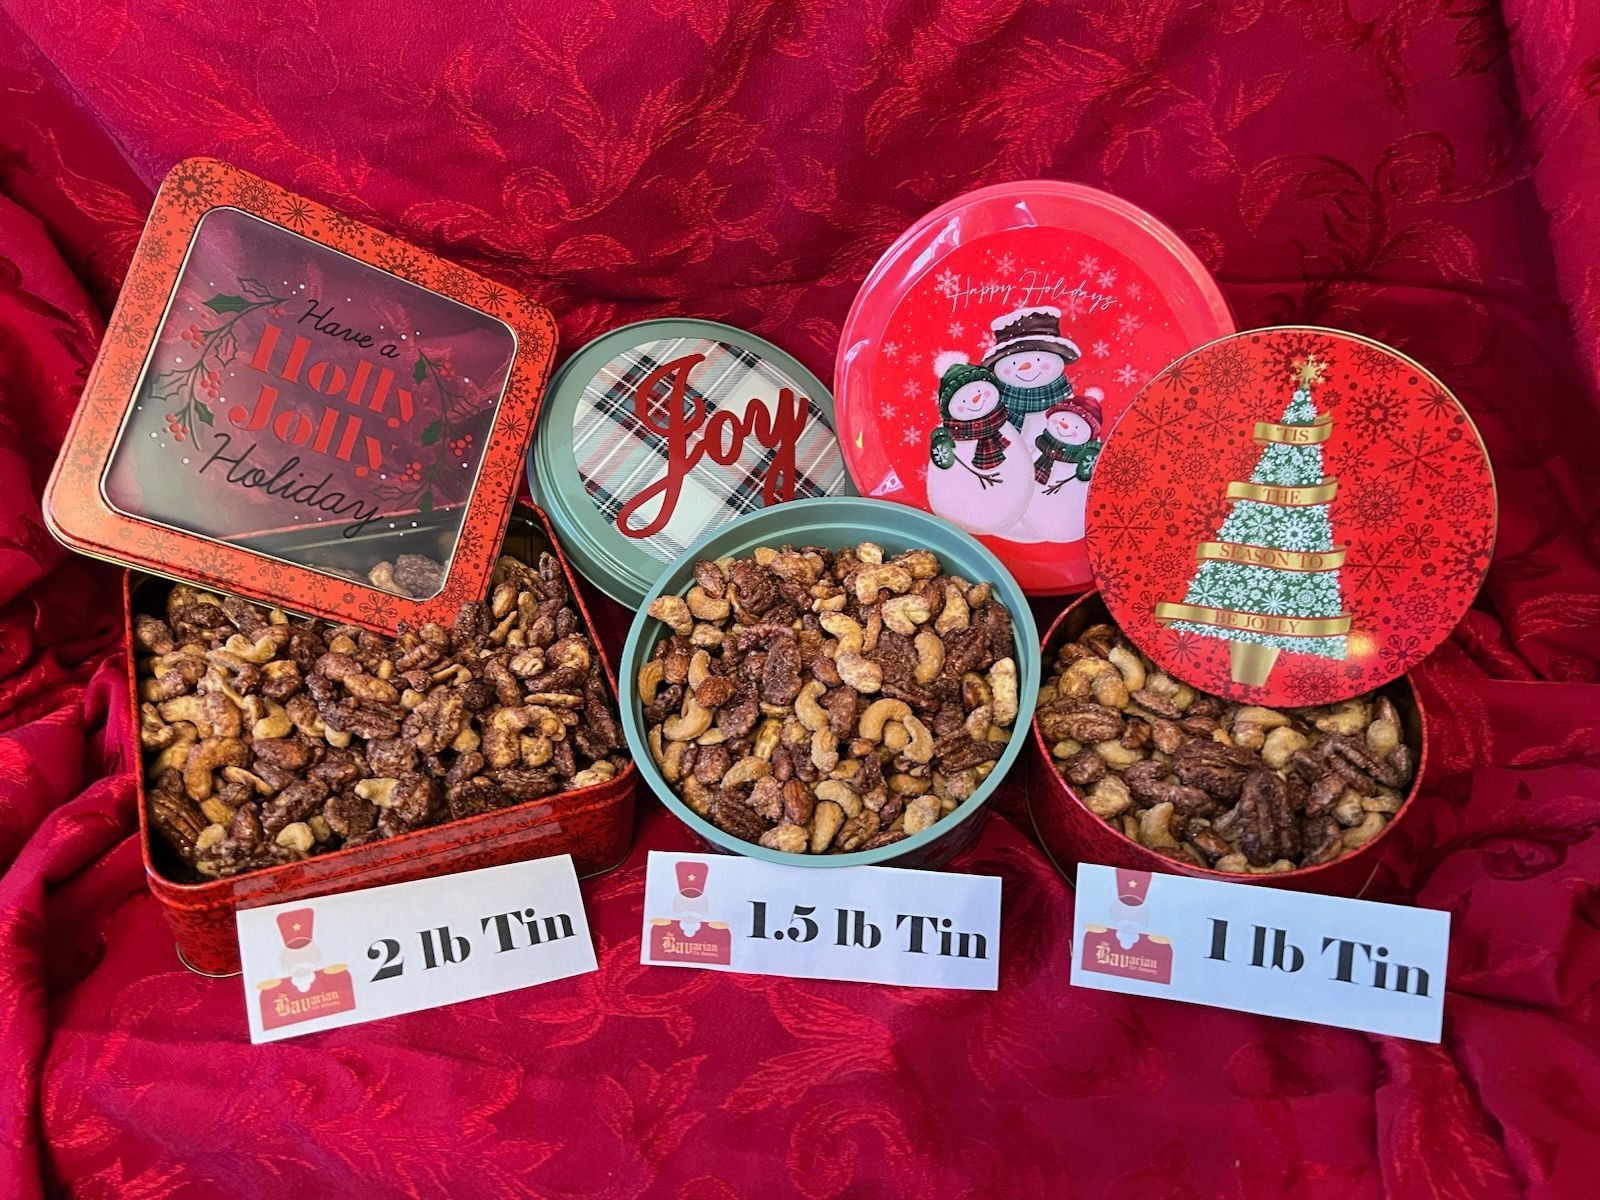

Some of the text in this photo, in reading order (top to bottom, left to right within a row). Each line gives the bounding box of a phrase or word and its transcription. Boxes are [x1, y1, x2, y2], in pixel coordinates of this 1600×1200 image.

[946, 270, 1118, 313] Happy Holidays
[298, 300, 400, 358] Have a
[251, 322, 414, 428] Holly
[228, 384, 383, 477] Jolly
[616, 354, 809, 539] Joy
[199, 433, 384, 538] Holiday
[1263, 488, 1301, 504] THE
[1220, 544, 1323, 569] SEASON TO
[1215, 612, 1301, 634] BE JOLLY
[367, 908, 577, 983] 2 lb Tin
[662, 936, 718, 954] Bavarian
[747, 900, 989, 960] 1.5 lb Tin
[1095, 945, 1157, 968] Bavarian
[1203, 917, 1433, 998] 1 lb Tin
[274, 991, 339, 1017] Bavarian
